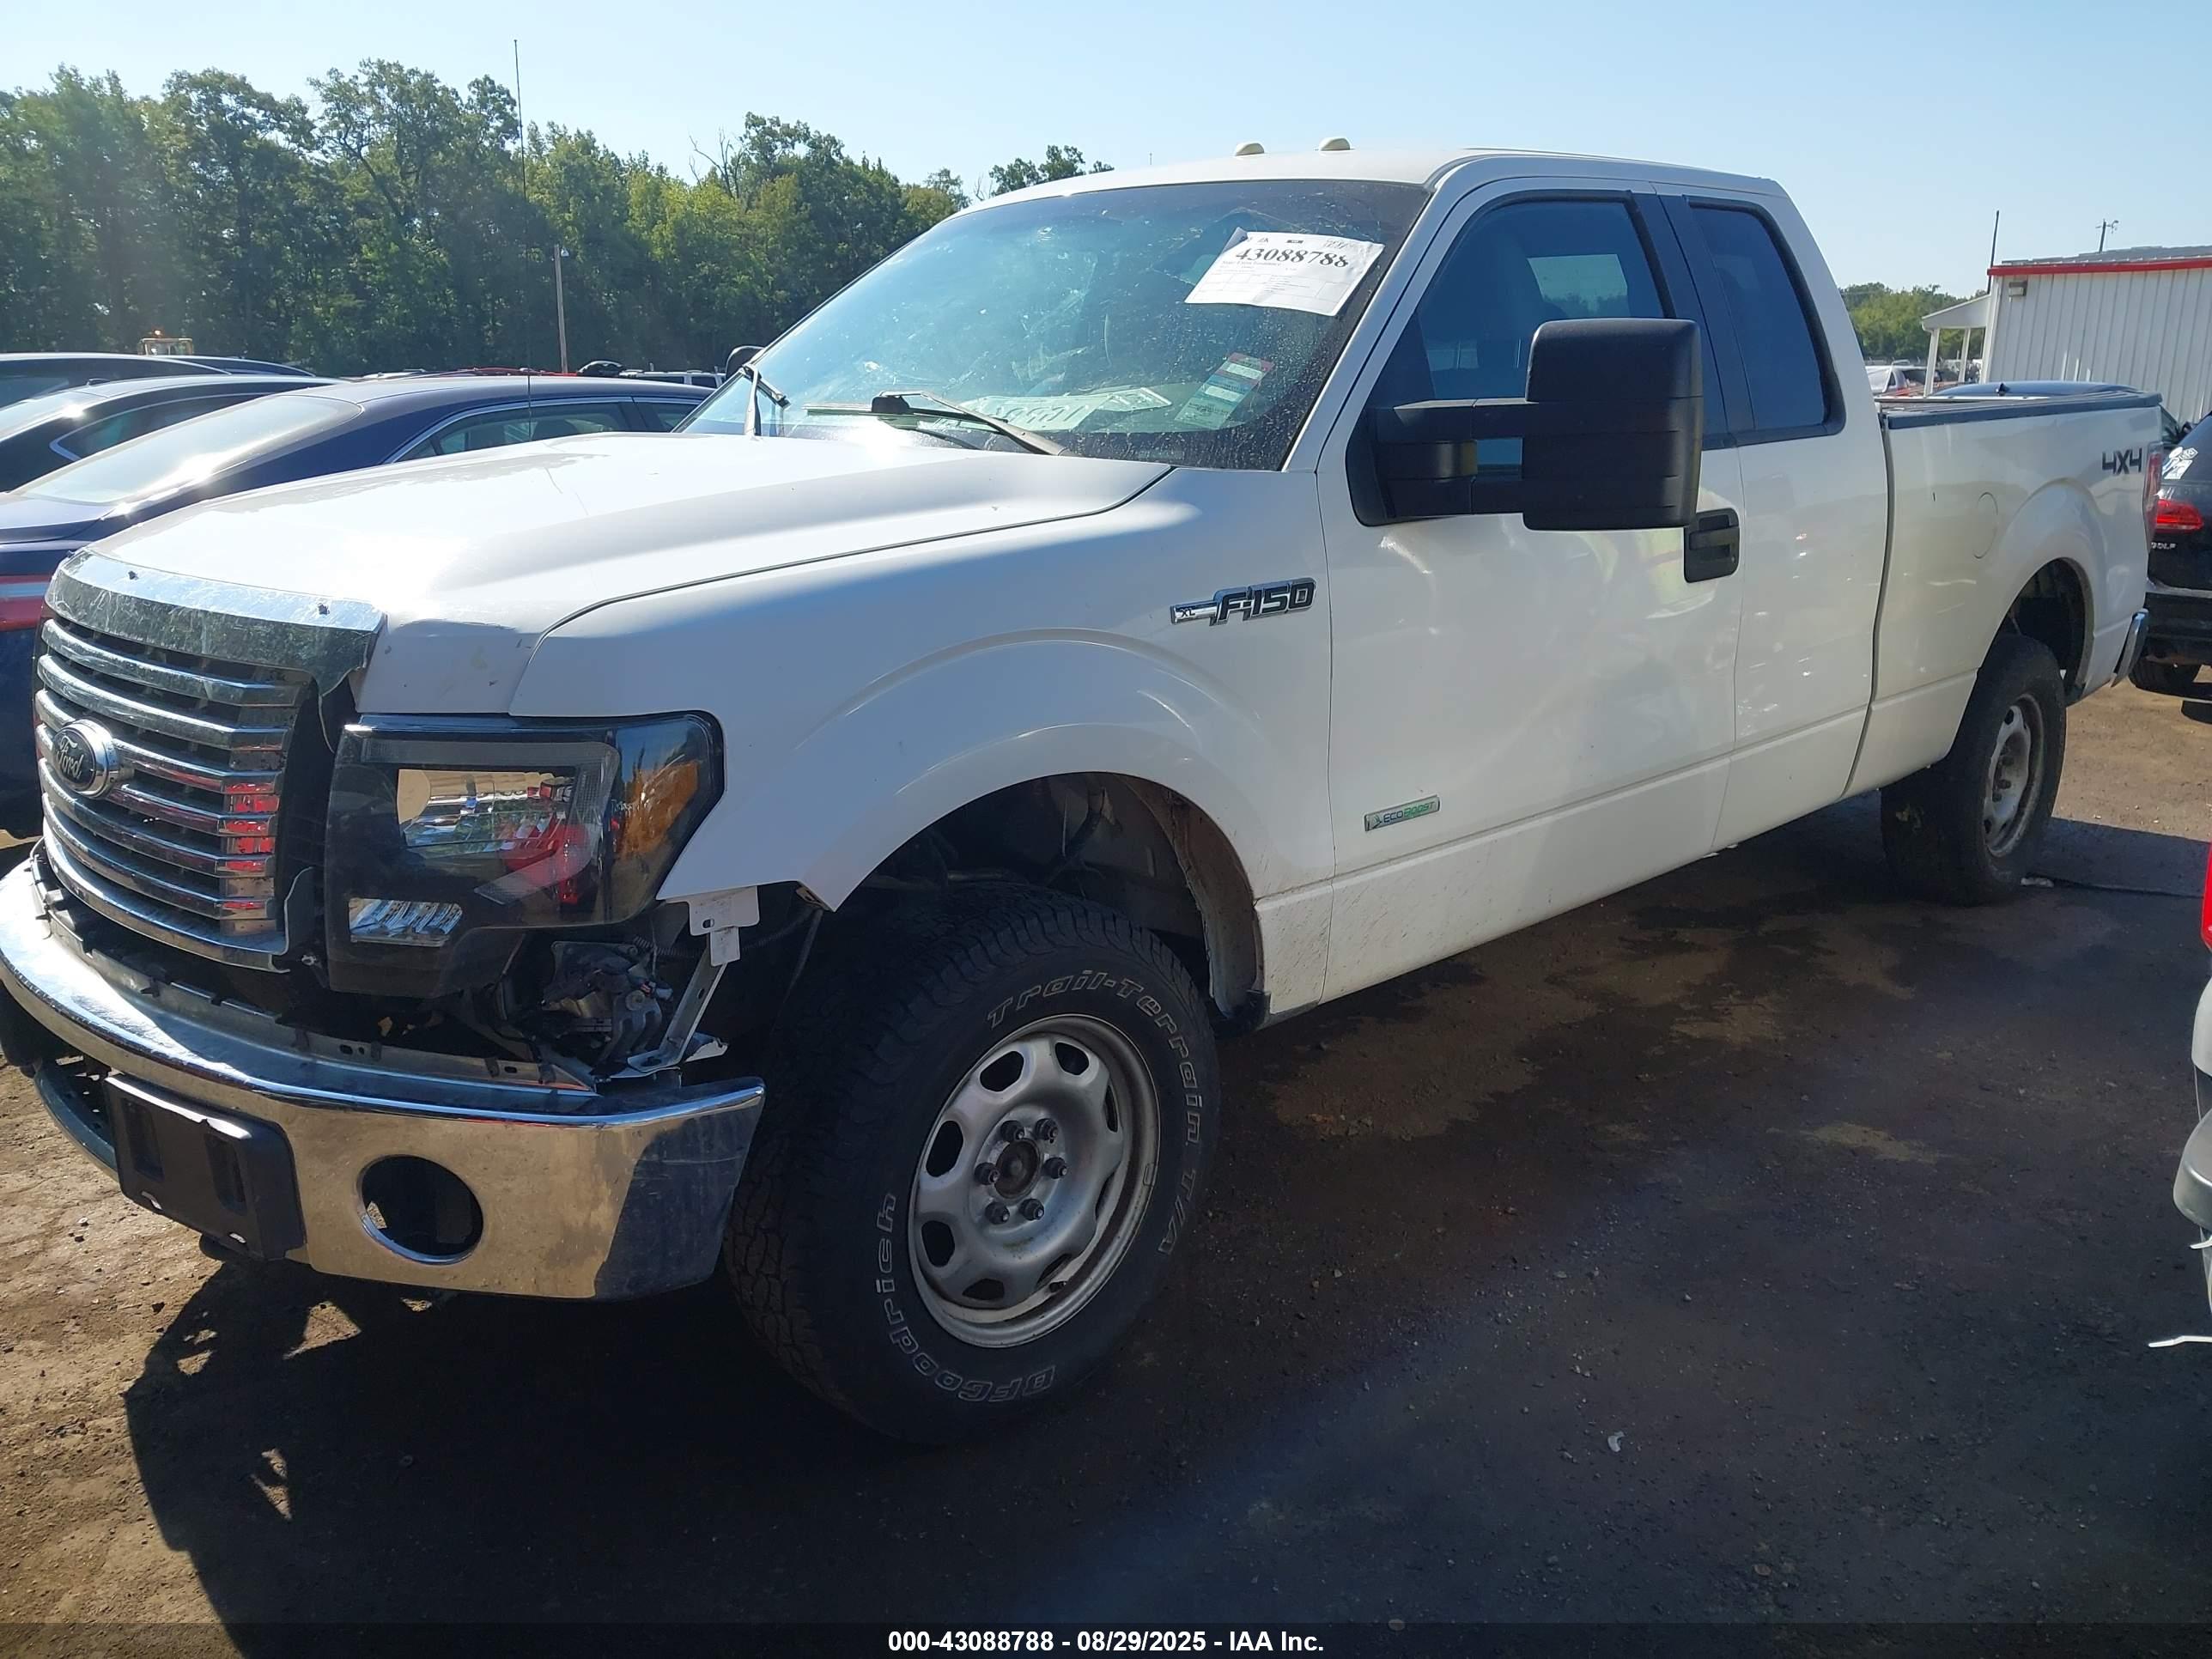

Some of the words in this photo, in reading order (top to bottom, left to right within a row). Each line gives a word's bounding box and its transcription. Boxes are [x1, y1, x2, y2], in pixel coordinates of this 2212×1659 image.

[1236, 246, 1349, 269] 43088788
[2102, 447, 2142, 474] 4X4
[1181, 608, 1195, 617] XL
[1214, 578, 1316, 625] F-150
[56, 735, 84, 780] Ford
[1382, 800, 1436, 823] ECOBOOST
[987, 970, 1203, 1146] Trail-Terrain
[876, 1194, 1057, 1402] BFGoodrich
